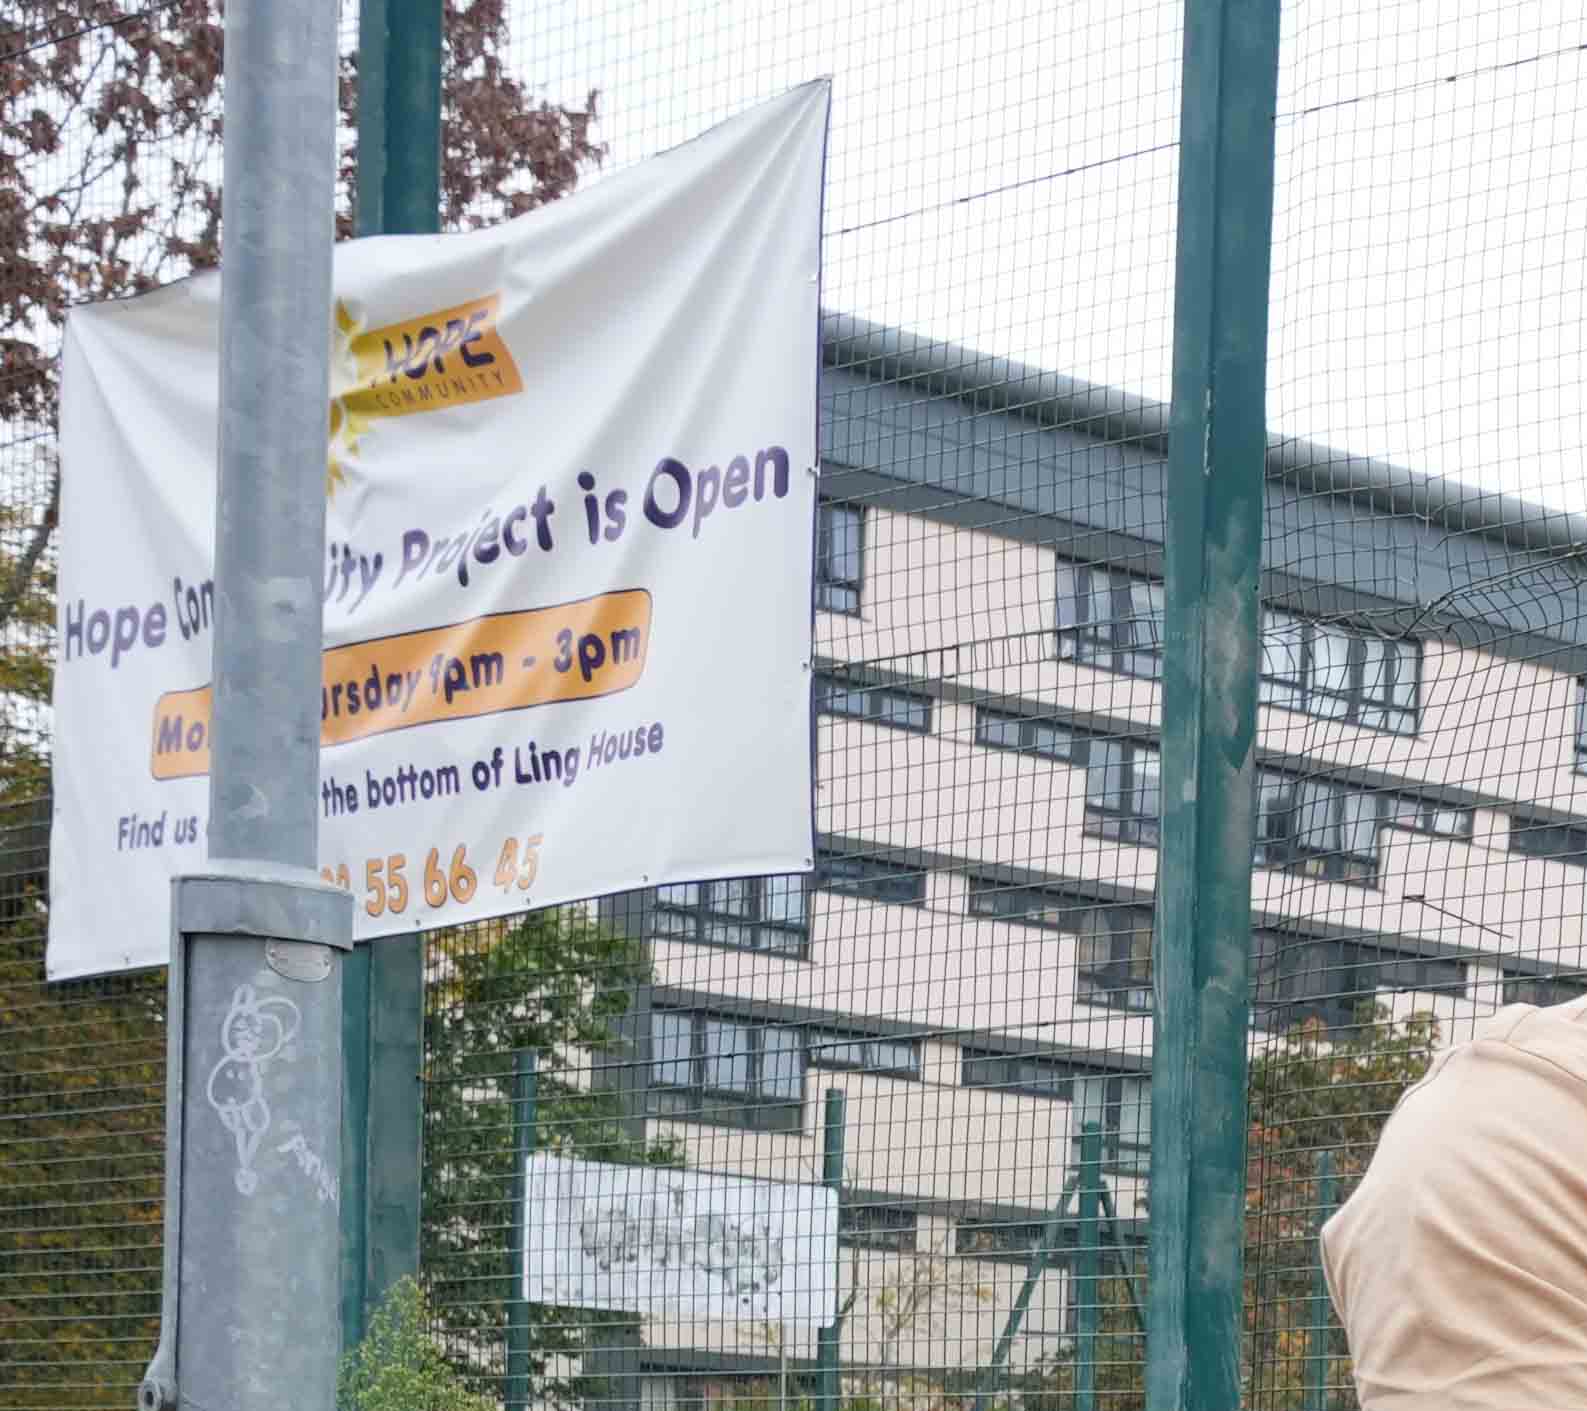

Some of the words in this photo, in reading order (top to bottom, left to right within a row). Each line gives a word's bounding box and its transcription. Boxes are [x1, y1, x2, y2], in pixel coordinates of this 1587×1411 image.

[382, 309, 495, 384] HOPE
[376, 368, 506, 409] COMMUNITY
[65, 599, 167, 669] Hope
[393, 485, 556, 588] Project
[577, 471, 628, 545] is
[642, 445, 790, 541] Open
[553, 627, 642, 682] 3pm
[117, 810, 168, 851] Find
[174, 815, 198, 845] us
[322, 778, 359, 817] the
[366, 764, 461, 809] bottom
[472, 746, 505, 792] of
[515, 741, 580, 788] Ling
[586, 721, 665, 771] House
[365, 853, 409, 918] 55
[423, 843, 478, 909] 66
[492, 832, 544, 895] 45
